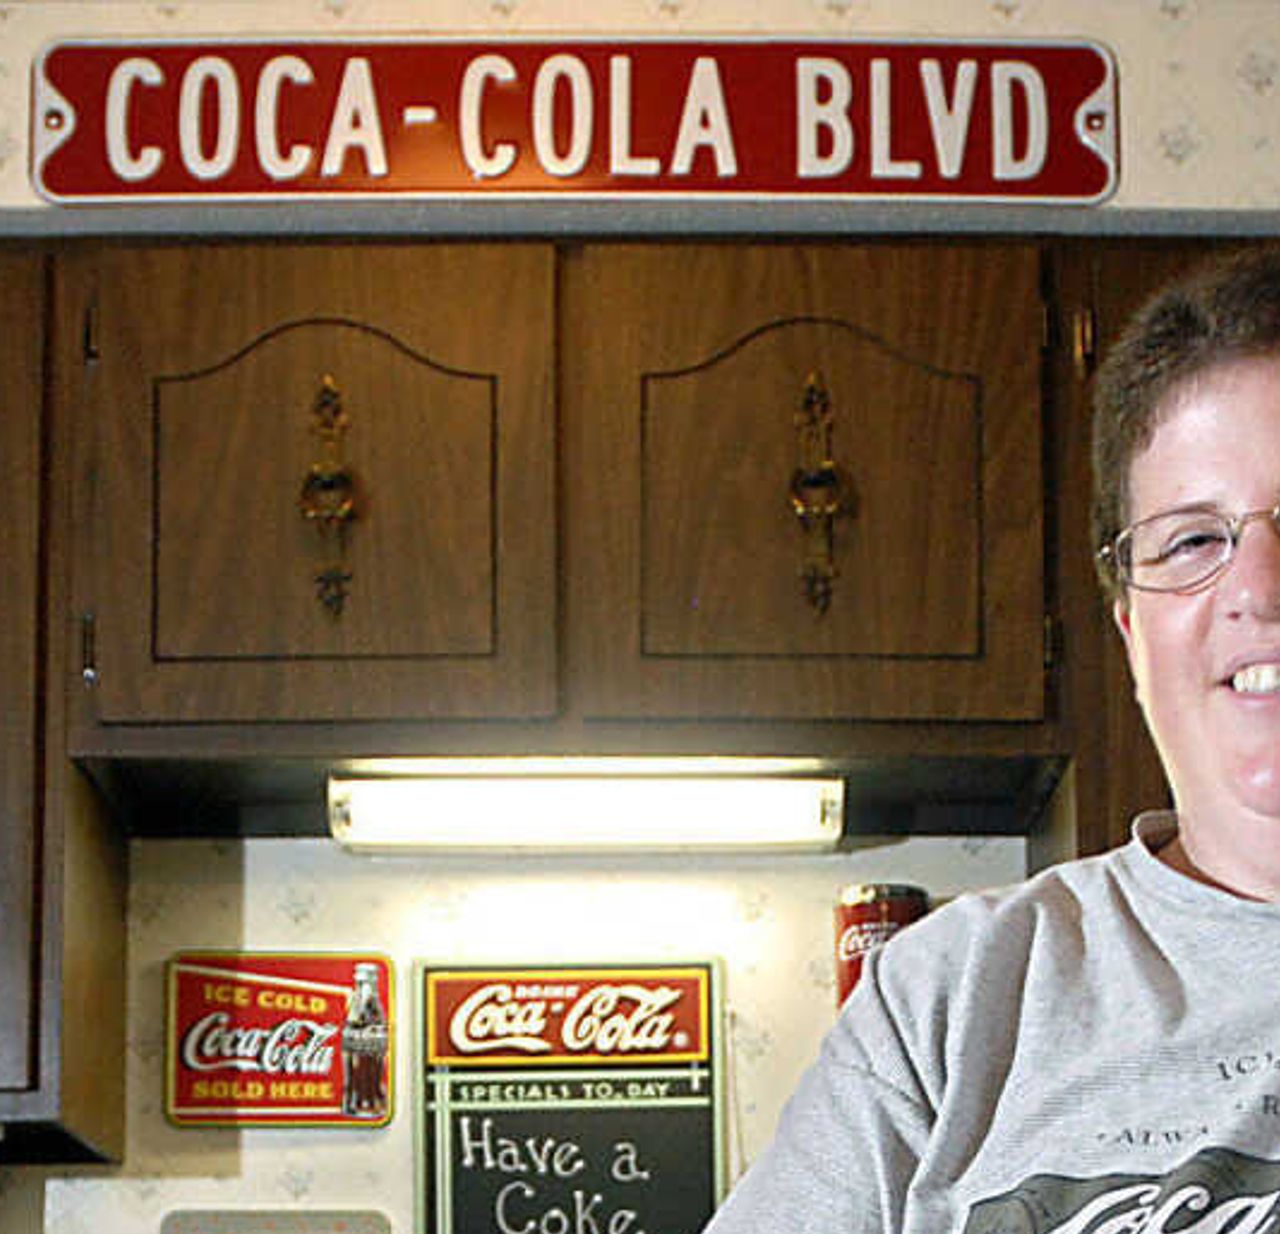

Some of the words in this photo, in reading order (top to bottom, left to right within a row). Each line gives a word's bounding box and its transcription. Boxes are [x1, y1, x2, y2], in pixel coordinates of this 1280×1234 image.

[104, 52, 738, 183] COCA-COLA
[796, 57, 1050, 182] BLVD
[204, 983, 252, 1007] ICE
[256, 990, 328, 1015] COLD
[449, 983, 684, 1053] Coca-Cola
[183, 1012, 340, 1075] Coca-Cola
[192, 1080, 264, 1099] SOLD
[270, 1081, 335, 1099] HERE
[459, 1083, 571, 1101] SPECIALS
[459, 1116, 585, 1176] Have
[611, 1141, 650, 1181] a
